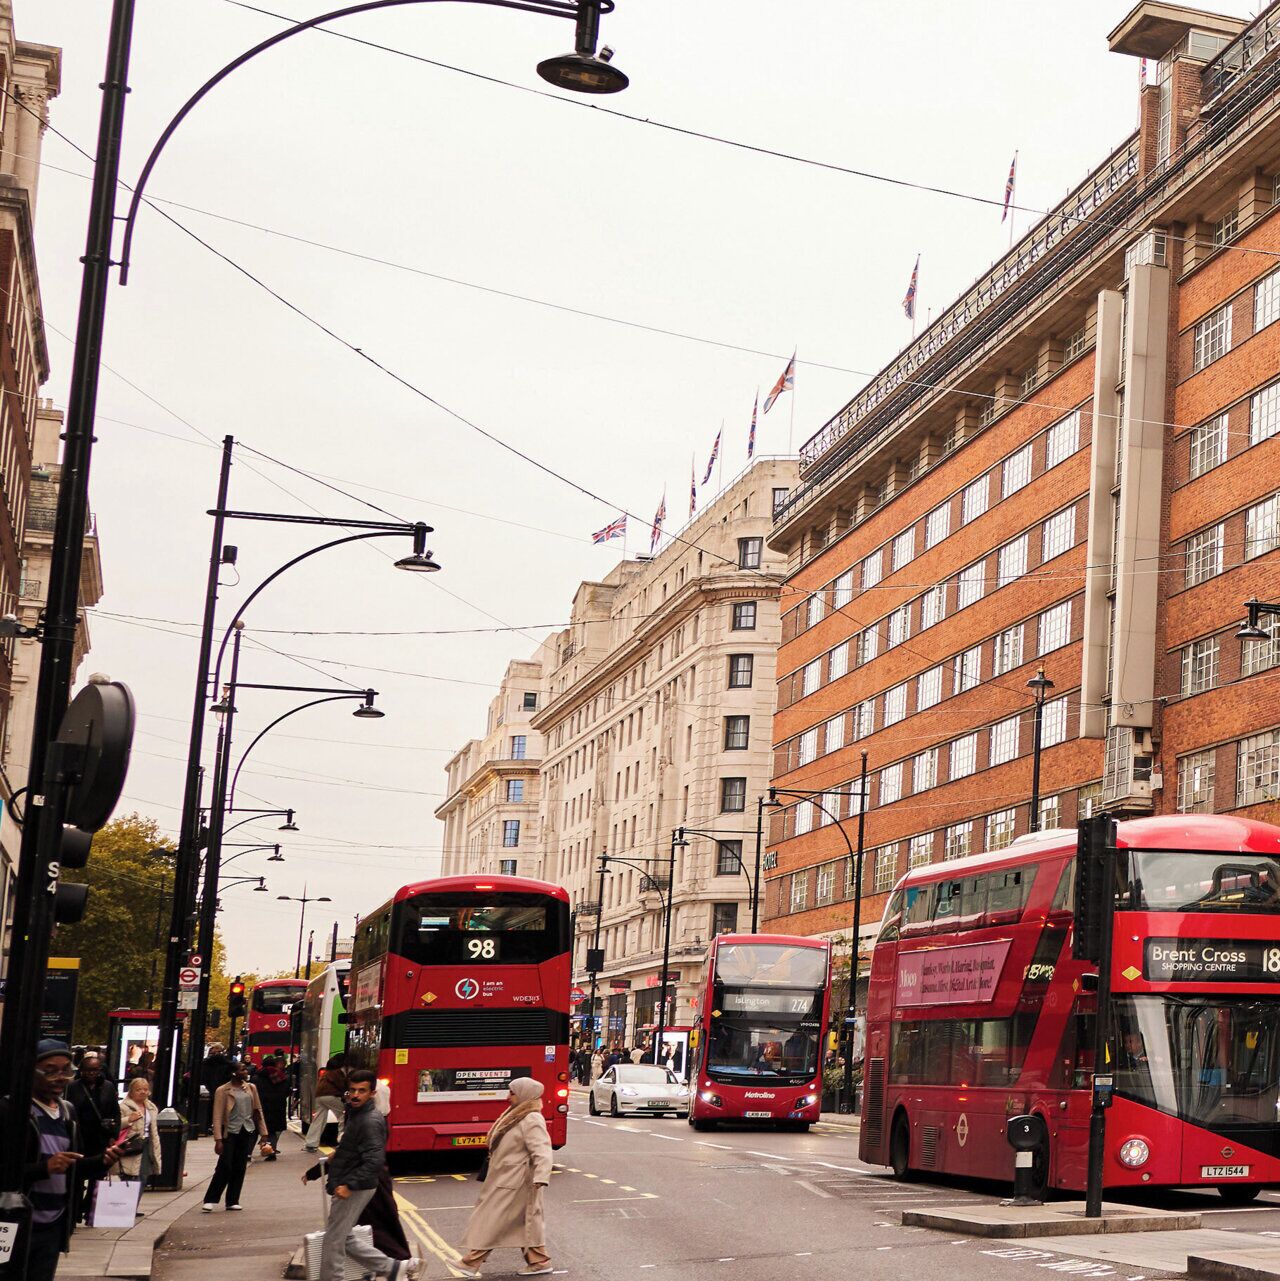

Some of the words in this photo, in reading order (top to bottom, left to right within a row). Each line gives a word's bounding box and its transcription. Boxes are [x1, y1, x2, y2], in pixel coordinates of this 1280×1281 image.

[47, 861, 60, 878] S
[46, 880, 57, 895] 4
[467, 939, 496, 959] 98
[1152, 946, 1197, 963] Brent
[1201, 947, 1247, 964] Cross
[1161, 962, 1203, 972] SHOPPING
[1204, 963, 1237, 972] CENTRE
[791, 999, 808, 1012] 274
[744, 1091, 776, 1100] Metroline
[457, 1137, 476, 1145] LV74
[1206, 1167, 1225, 1176] LTZ
[1225, 1166, 1245, 1176] 1544
